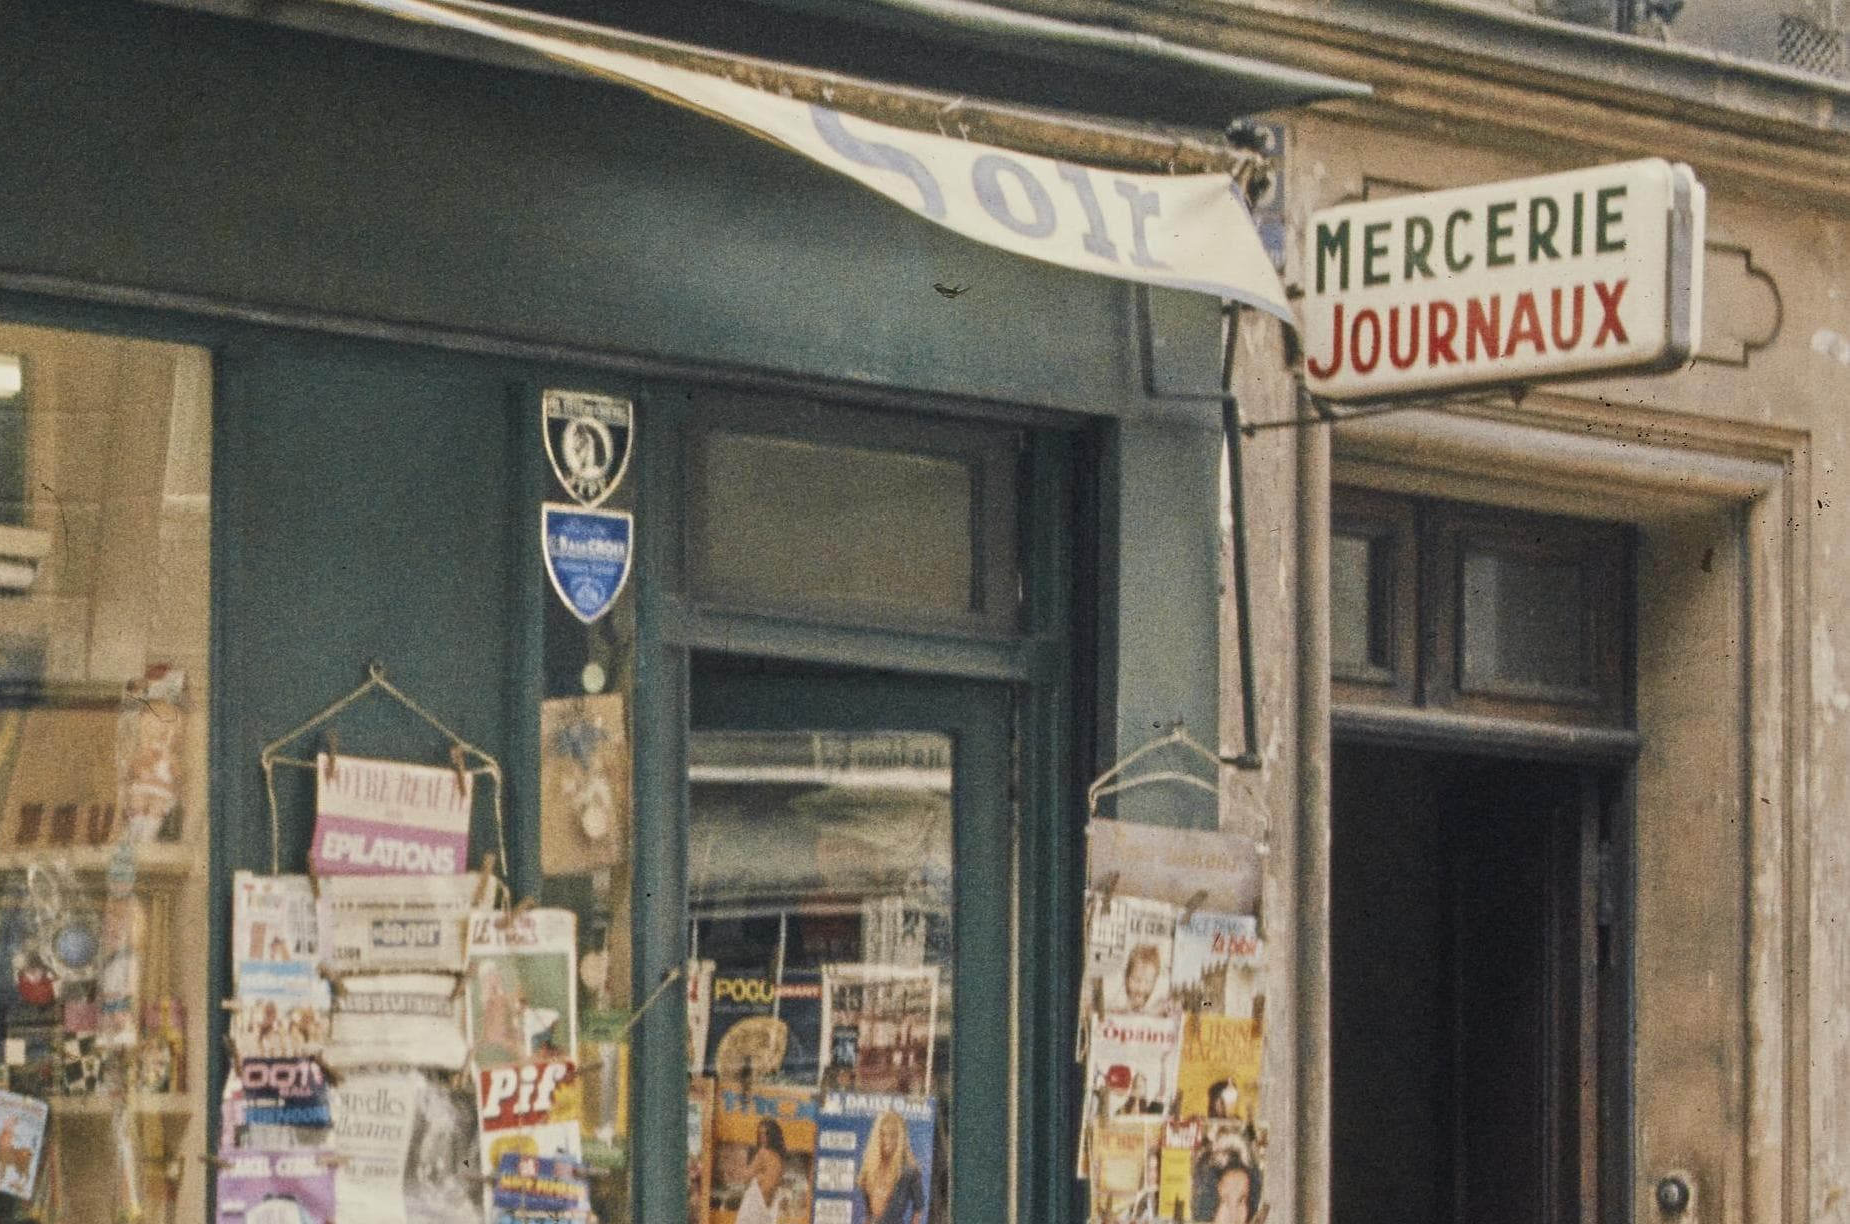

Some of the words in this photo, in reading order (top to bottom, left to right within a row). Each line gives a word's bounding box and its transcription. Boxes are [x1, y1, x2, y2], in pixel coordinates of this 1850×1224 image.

[1316, 186, 1628, 293] MERCERIE
[1307, 279, 1630, 380] JOURNAUX
[482, 1062, 568, 1119] Pif
